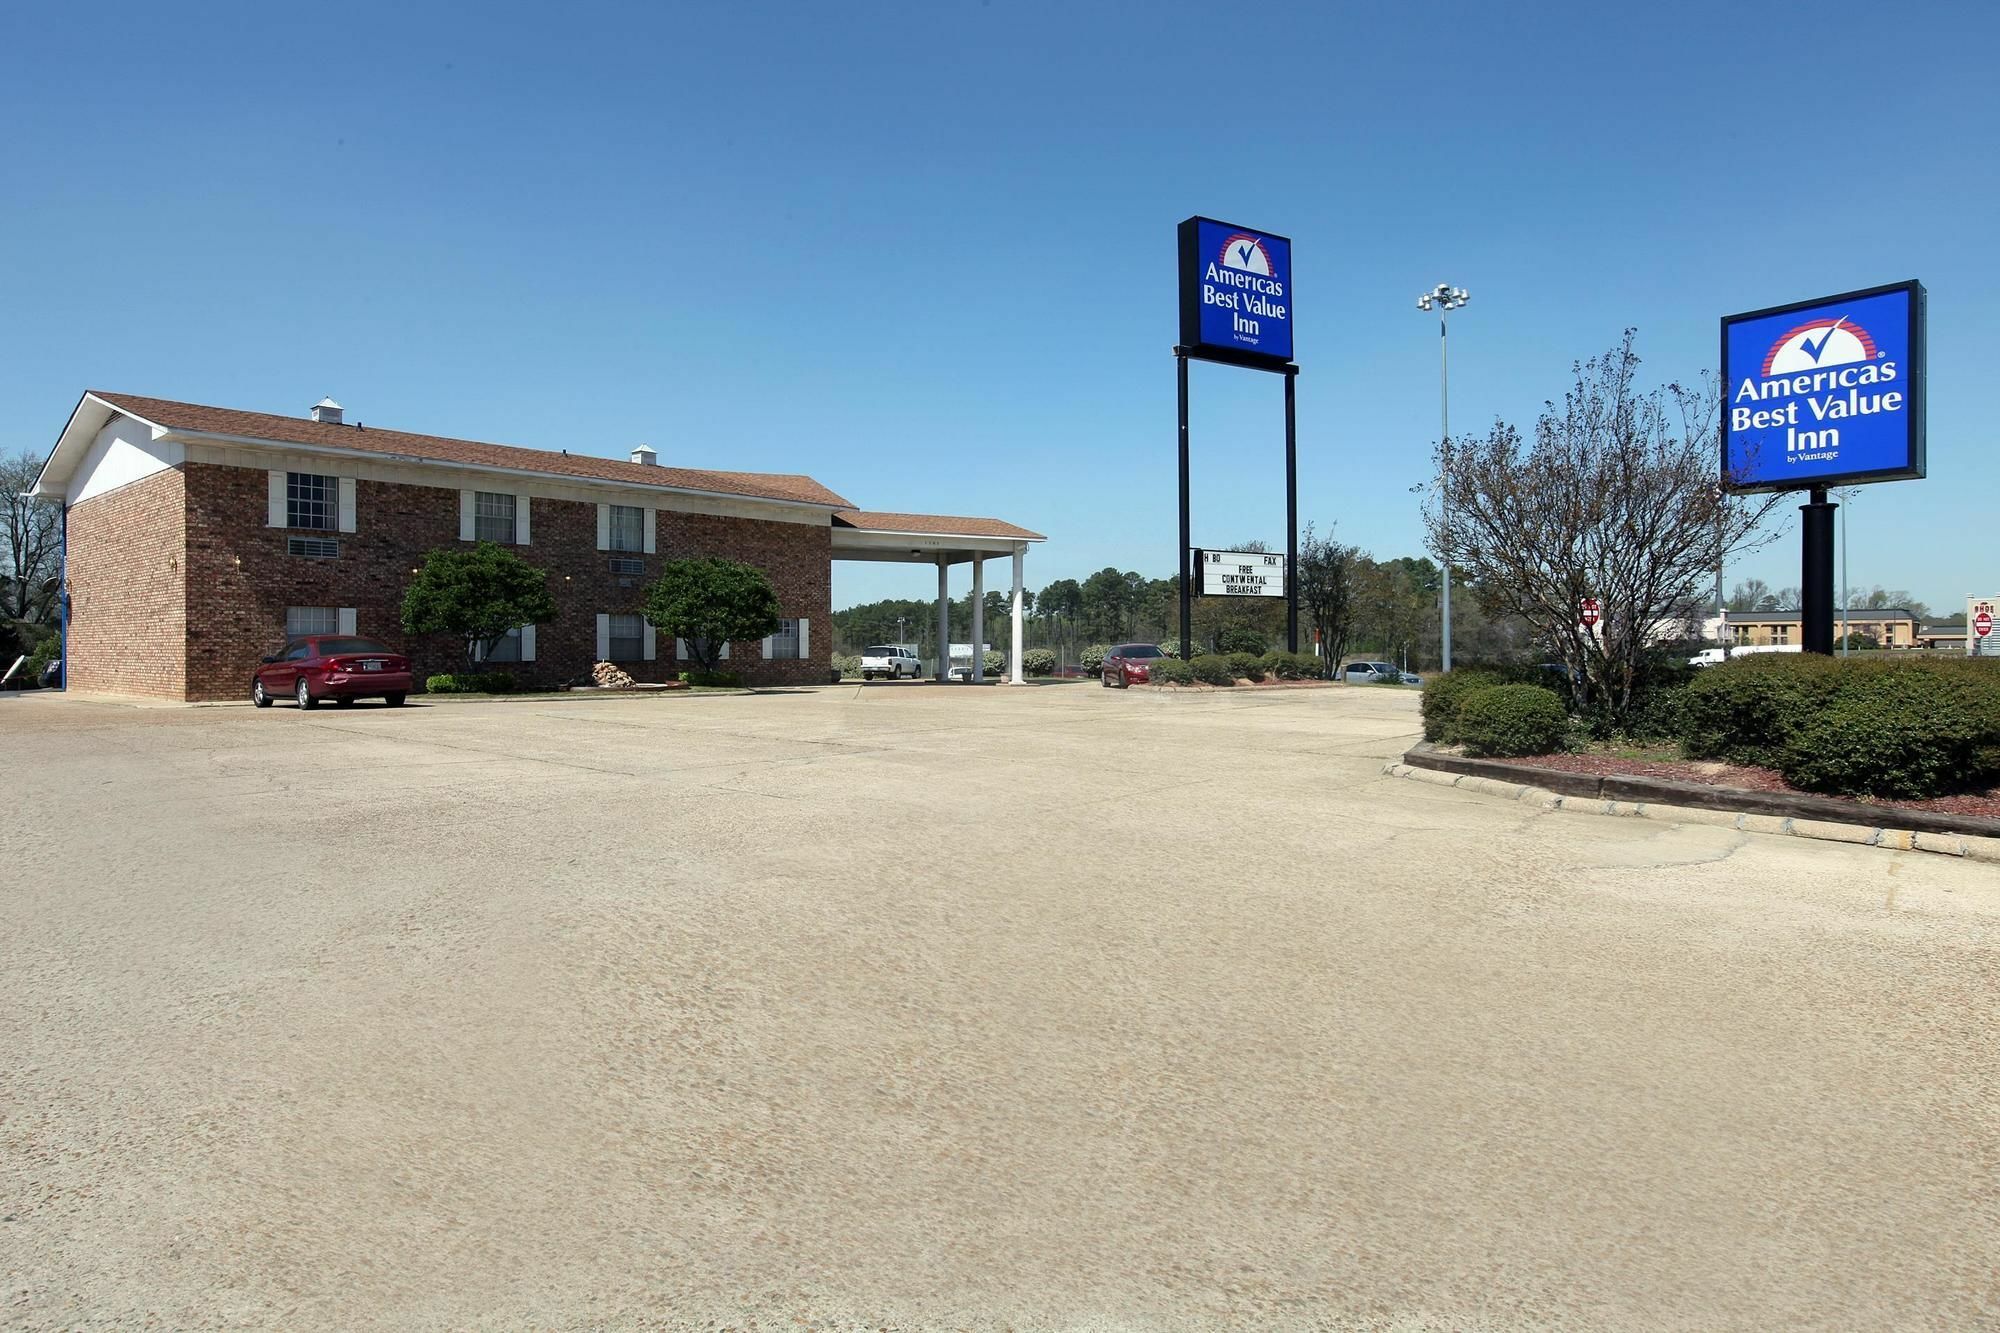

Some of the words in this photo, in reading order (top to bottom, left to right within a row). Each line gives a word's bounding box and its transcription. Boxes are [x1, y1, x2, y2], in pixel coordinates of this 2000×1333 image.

[1205, 262, 1283, 297] Americas
[1203, 285, 1240, 310] Best
[1243, 293, 1286, 320] Value
[1233, 312, 1260, 335] Inn
[1239, 334, 1259, 345] Vantage
[1735, 361, 1897, 403] Americas
[1732, 401, 1799, 432] Best
[1807, 388, 1903, 421] Value
[1787, 427, 1839, 452] Inn
[1787, 456, 1797, 464] by
[1797, 451, 1839, 461] Vantage
[1238, 565, 1253, 574] FREE
[1263, 556, 1277, 566] FAX
[1226, 585, 1262, 594] BREAKFAST
